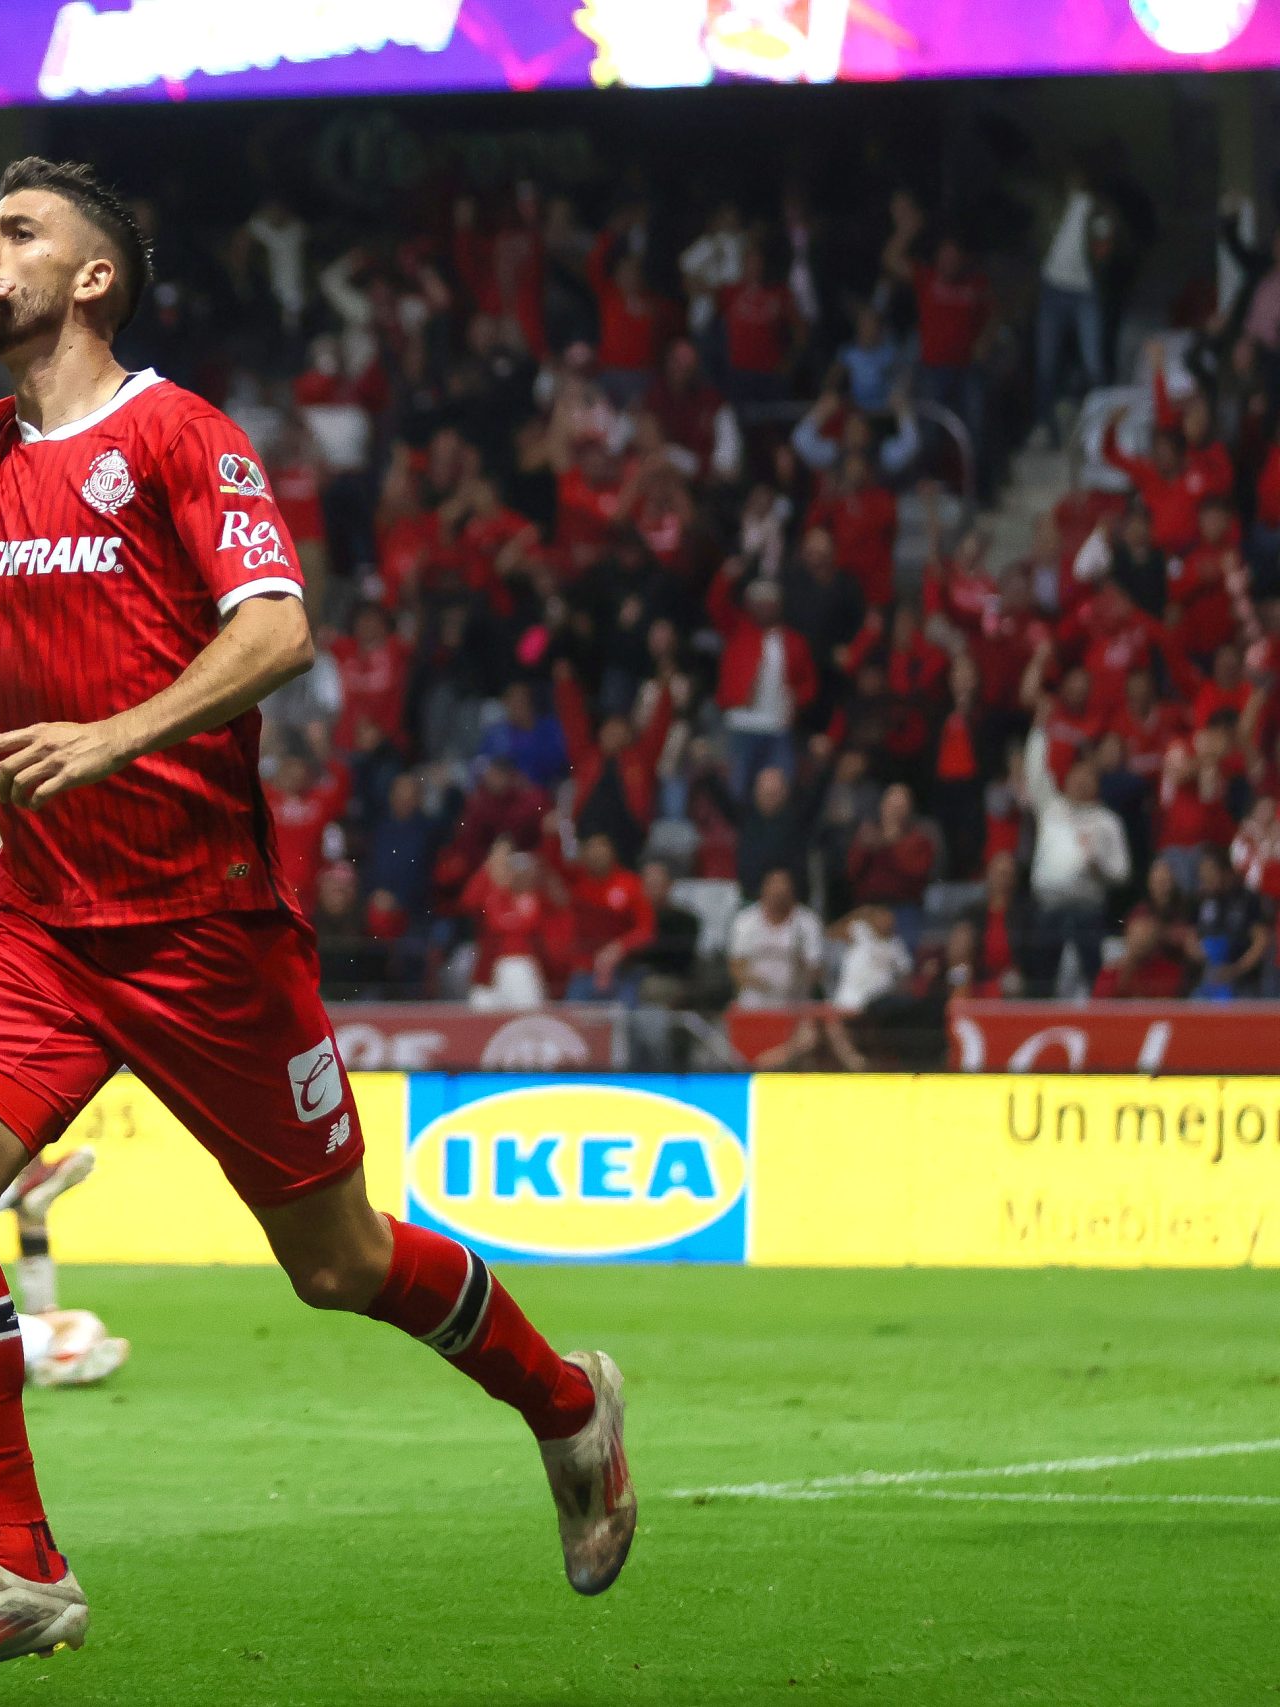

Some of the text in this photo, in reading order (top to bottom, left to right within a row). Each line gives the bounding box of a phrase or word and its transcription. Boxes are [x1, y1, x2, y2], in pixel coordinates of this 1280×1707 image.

[243, 543, 289, 569] Cola
[1007, 1080, 1280, 1164] Un mejo
[443, 1136, 718, 1199] IKEA
